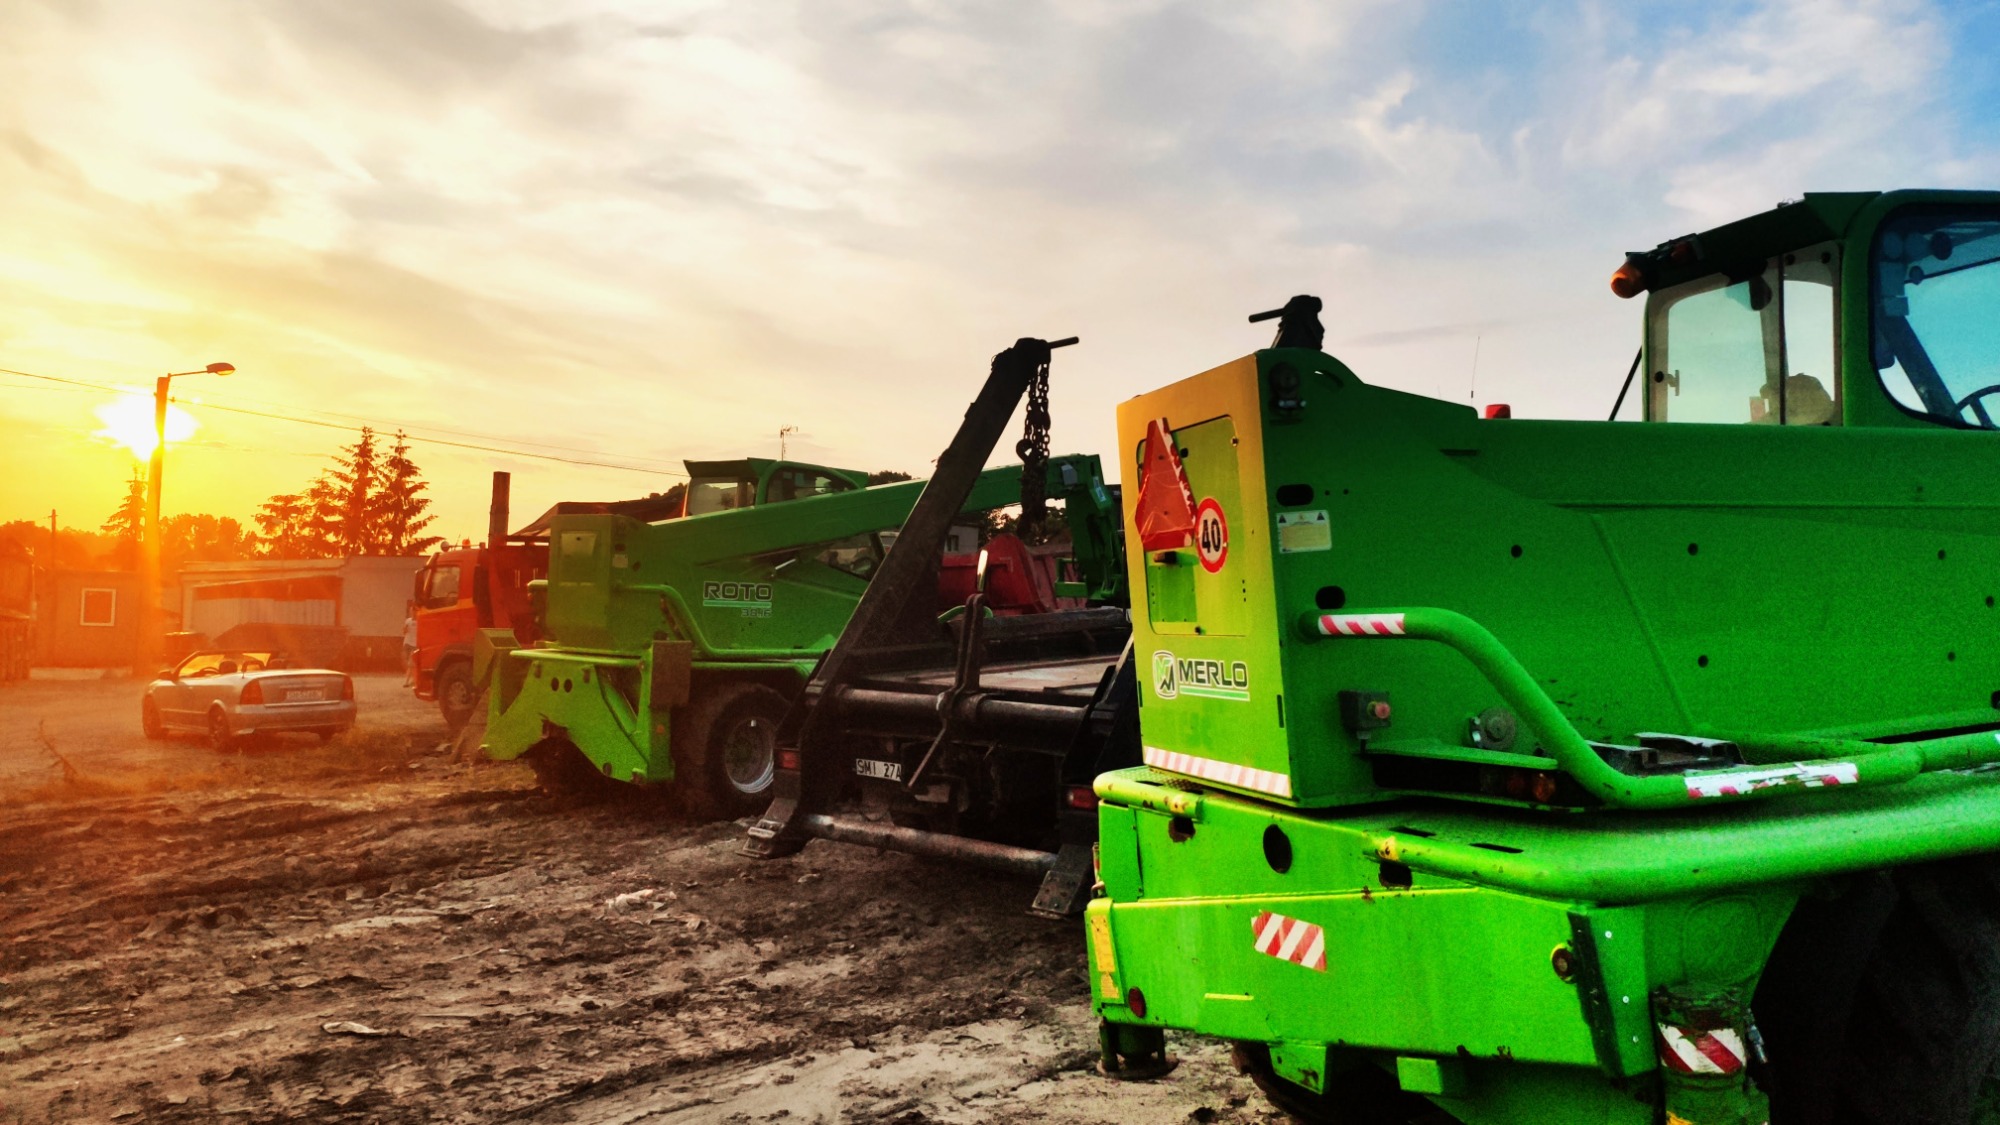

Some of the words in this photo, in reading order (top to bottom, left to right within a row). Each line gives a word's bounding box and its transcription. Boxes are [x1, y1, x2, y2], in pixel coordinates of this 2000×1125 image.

[1201, 518, 1221, 553] 40
[704, 581, 772, 601] ROTO
[1178, 659, 1248, 688] MERLO
[857, 760, 876, 775] SMI
